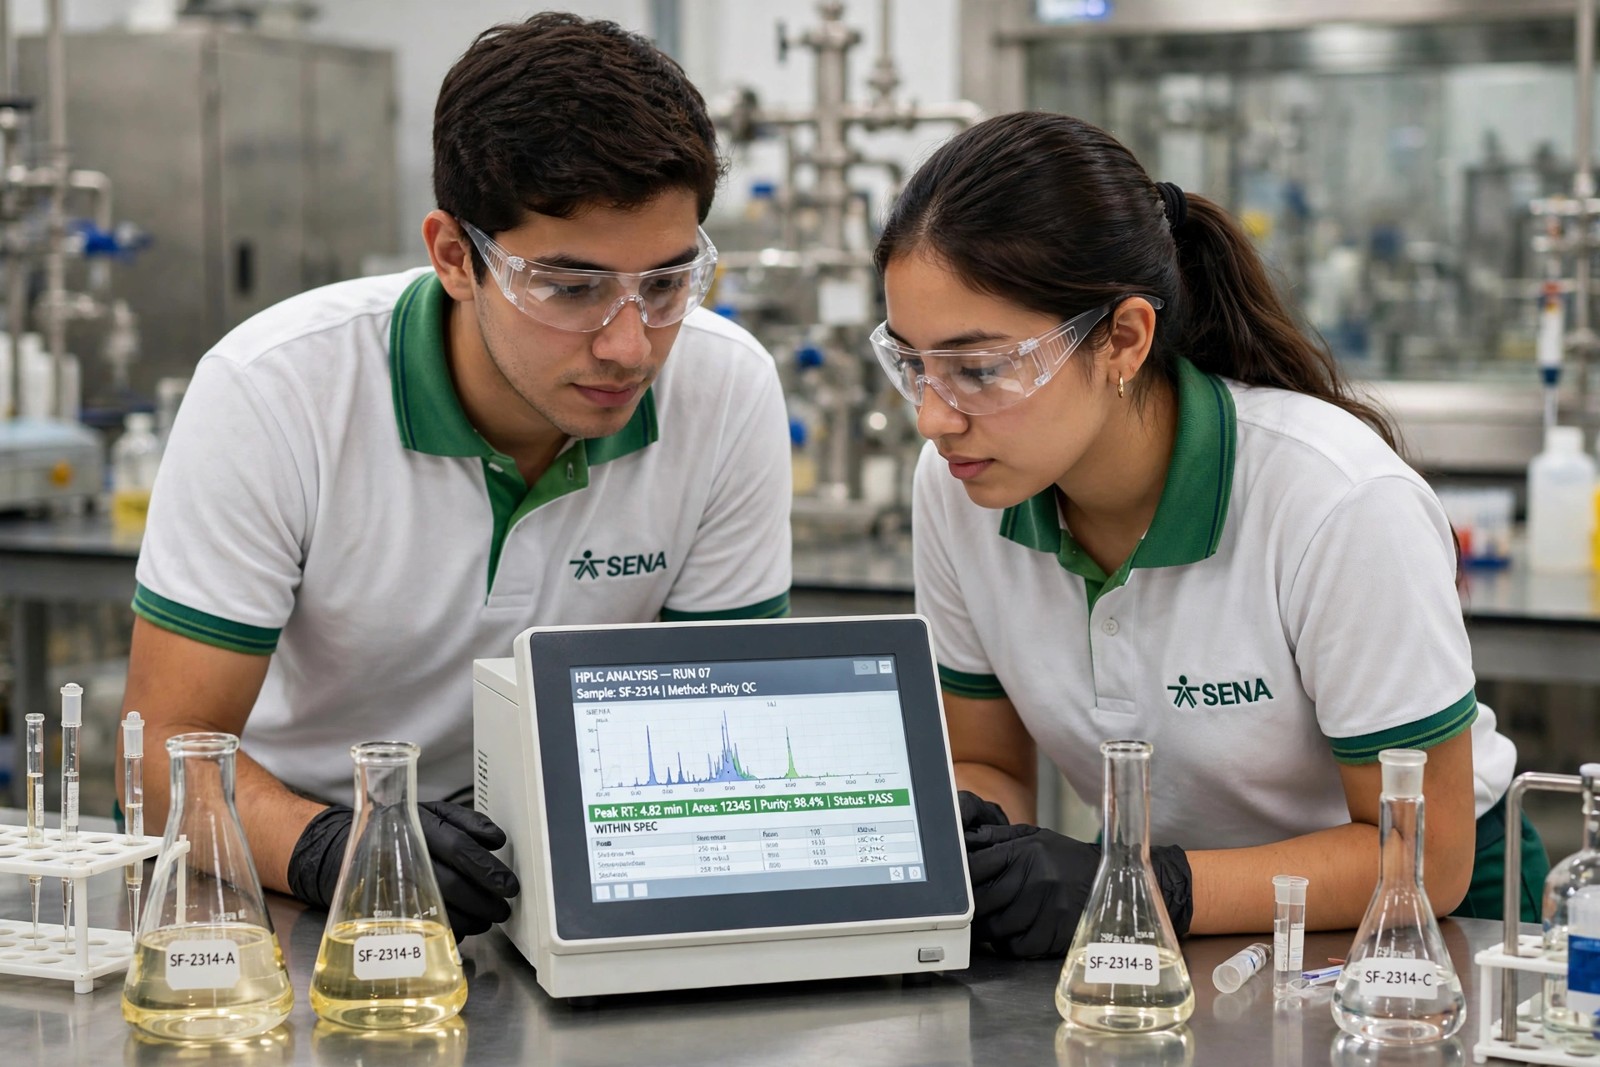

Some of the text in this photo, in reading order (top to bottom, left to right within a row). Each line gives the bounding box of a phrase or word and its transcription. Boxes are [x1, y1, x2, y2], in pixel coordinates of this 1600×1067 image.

[607, 551, 667, 577] SENA
[575, 671, 603, 683] HPLC
[606, 669, 659, 682] ANALYSIS
[673, 668, 696, 679] RUN
[698, 667, 711, 678] 07
[576, 687, 617, 701] Sample:
[619, 686, 660, 698] SF-2314
[668, 684, 709, 696] Method:
[710, 683, 739, 696] Purity
[741, 682, 757, 693] QC
[1202, 678, 1274, 706] SENA
[594, 807, 619, 819] Peak
[620, 806, 638, 817] RT:
[639, 805, 661, 816] 4.82
[663, 804, 682, 815] min
[692, 802, 718, 813] Area:
[720, 800, 751, 812] 12345
[760, 798, 792, 811] Purity:
[793, 796, 824, 808] 98.4%
[833, 794, 867, 806] Status:
[868, 793, 894, 804] PASS
[594, 821, 658, 834] WITHIN SPEC
[170, 951, 235, 967] SF-2314-A
[358, 946, 421, 962] SF-2314-B
[1089, 956, 1154, 971] SF-2314-B
[1365, 970, 1432, 987] SF-2314-C
